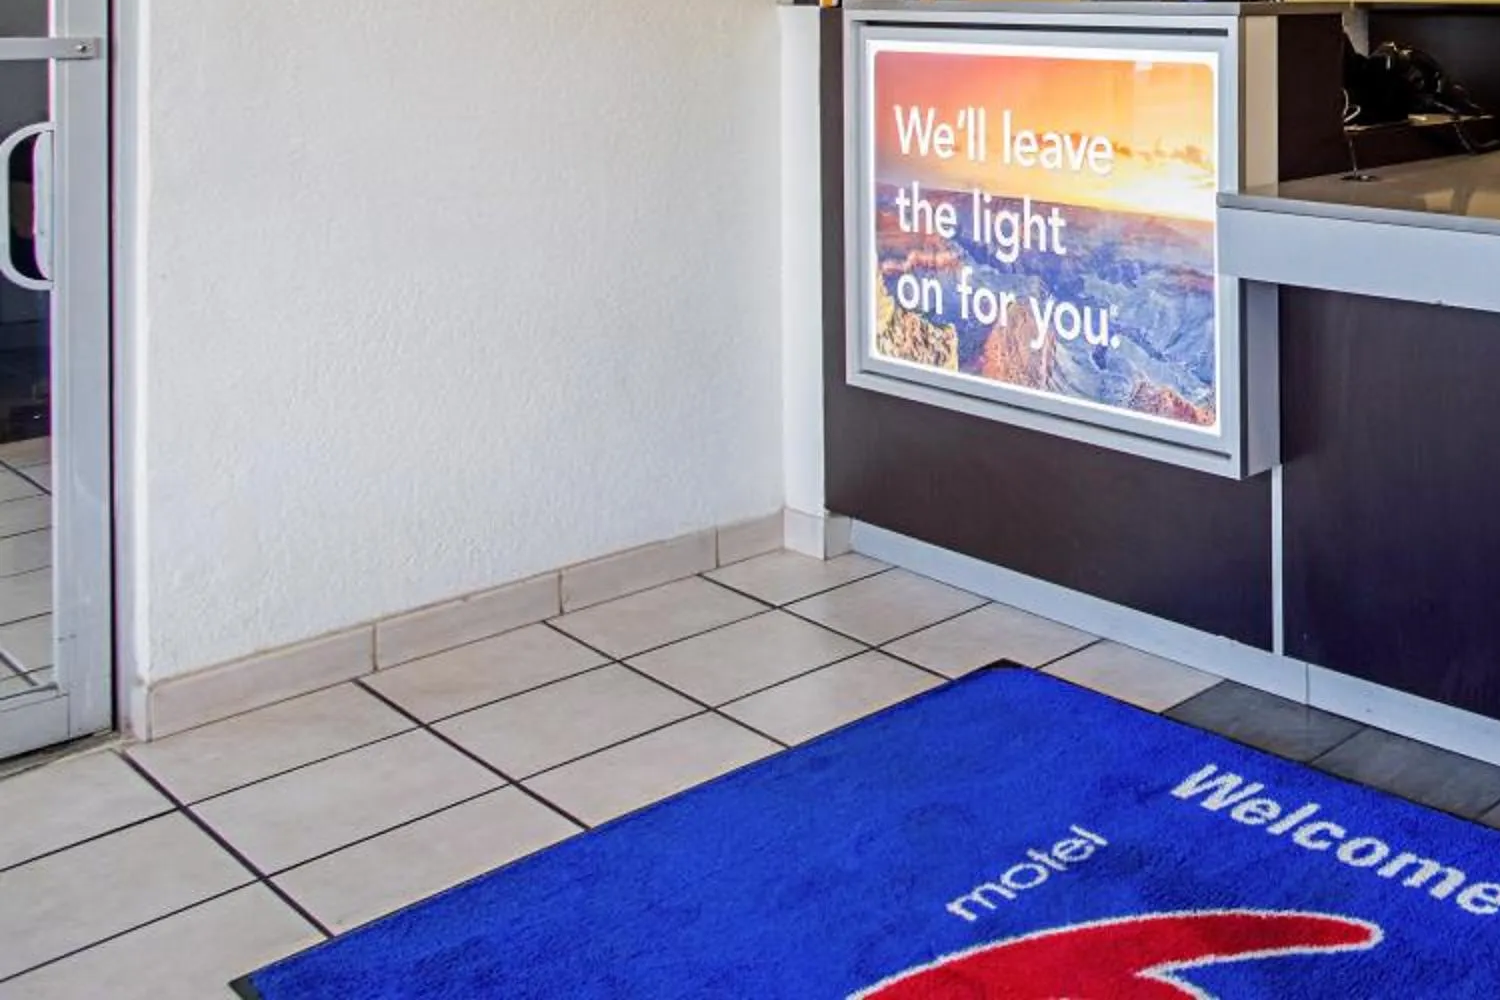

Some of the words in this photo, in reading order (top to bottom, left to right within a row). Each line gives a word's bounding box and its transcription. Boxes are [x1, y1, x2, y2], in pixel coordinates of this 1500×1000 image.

[894, 104, 986, 163] We'll
[1003, 109, 1114, 176] leave
[894, 180, 957, 240] the
[972, 187, 1068, 264] light
[896, 272, 944, 316] on
[956, 268, 1017, 328] for
[945, 824, 1108, 924] motel
